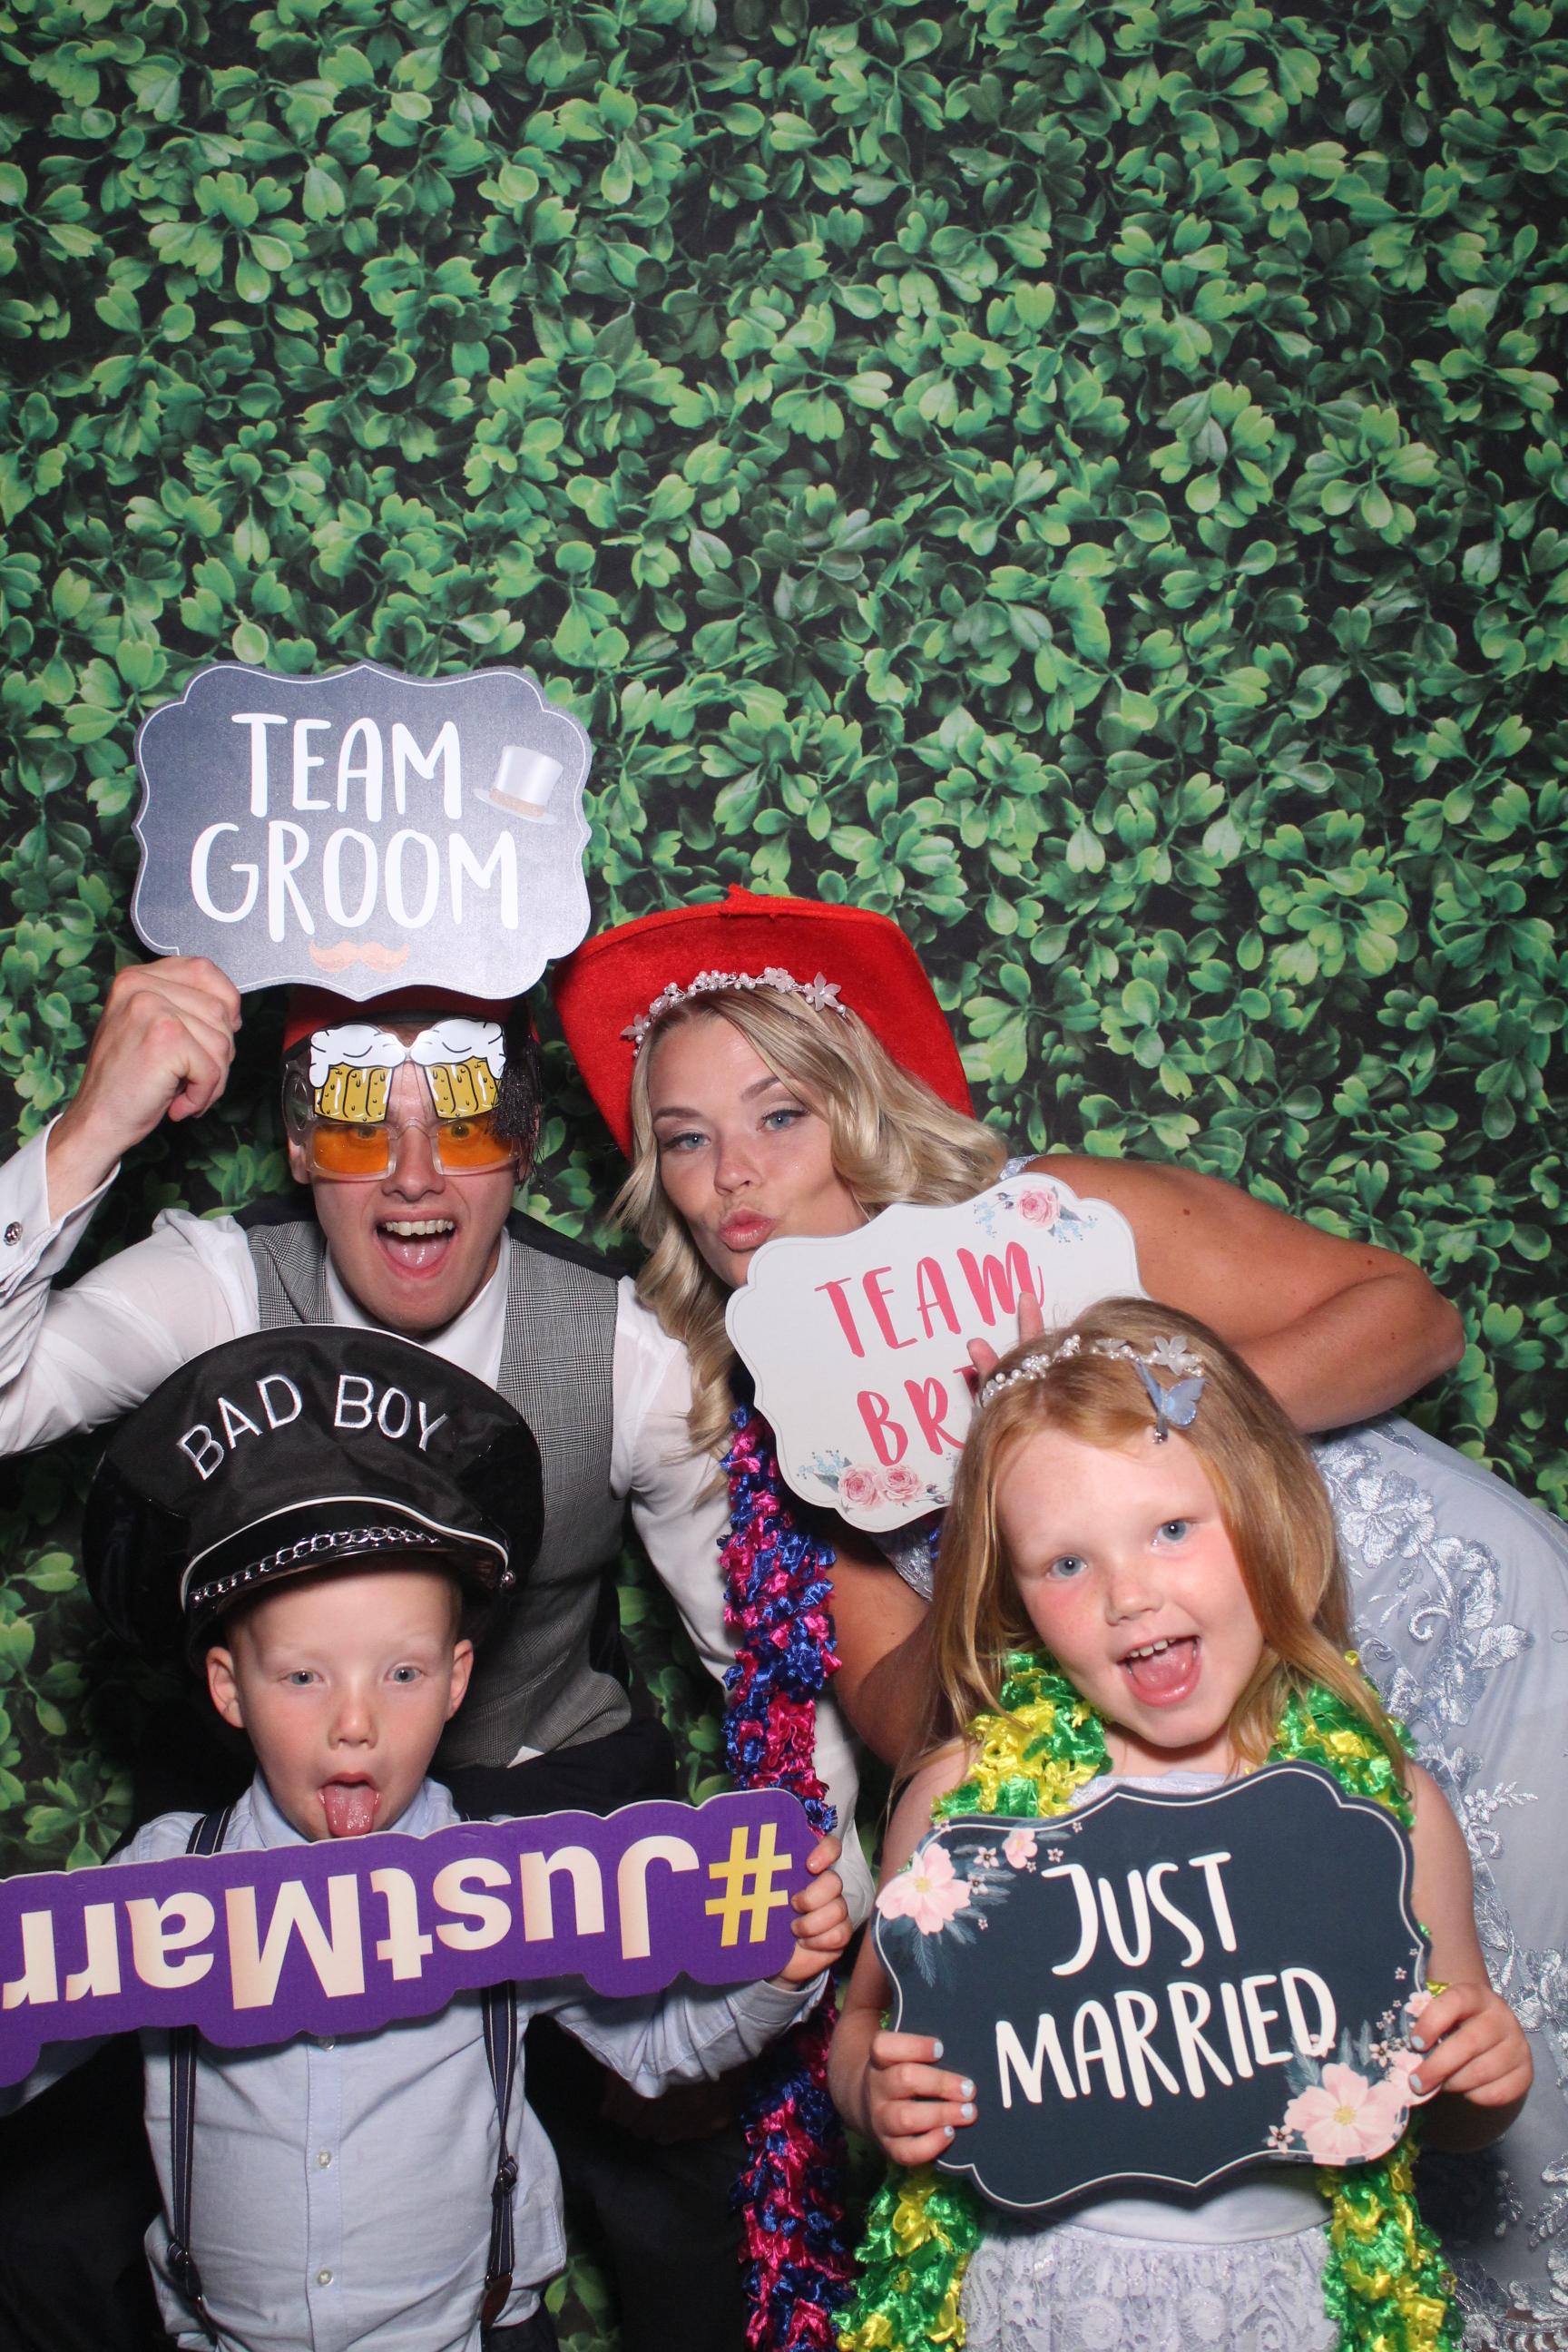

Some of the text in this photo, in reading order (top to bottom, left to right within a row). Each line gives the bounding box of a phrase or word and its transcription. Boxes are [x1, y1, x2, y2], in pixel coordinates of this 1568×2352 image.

[231, 712, 463, 823] TEAM
[191, 820, 518, 943] GROOM
[814, 1240, 1045, 1358] TEAM
[176, 1373, 448, 1481] BAD BOY
[2, 1823, 793, 2011] #JustMarr
[1041, 1851, 1238, 1976] JUST
[995, 1966, 1338, 2109] MARRIED
